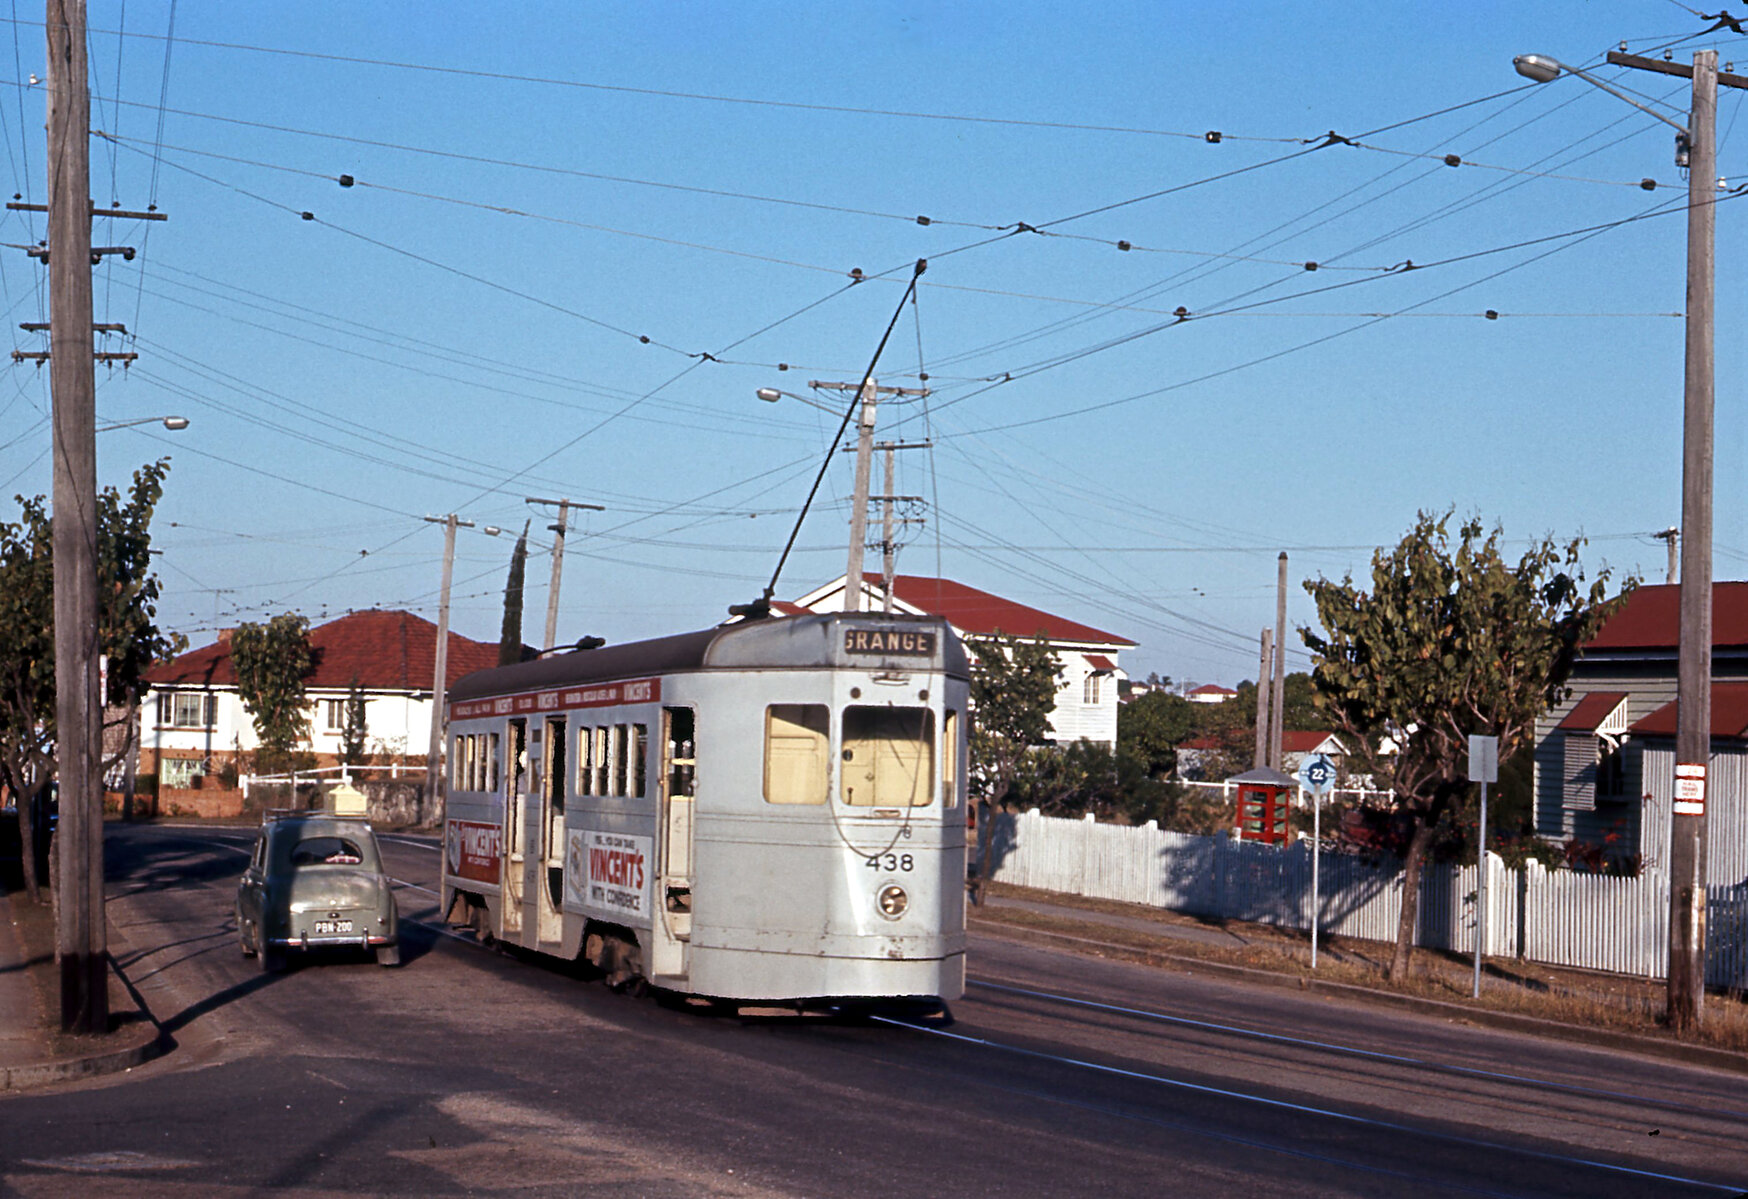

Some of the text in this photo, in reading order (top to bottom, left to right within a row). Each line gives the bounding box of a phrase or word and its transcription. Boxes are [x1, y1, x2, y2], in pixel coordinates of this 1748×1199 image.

[1312, 768, 1325, 780] 22
[590, 848, 644, 891] VINCENT'S
[865, 853, 914, 872] 438
